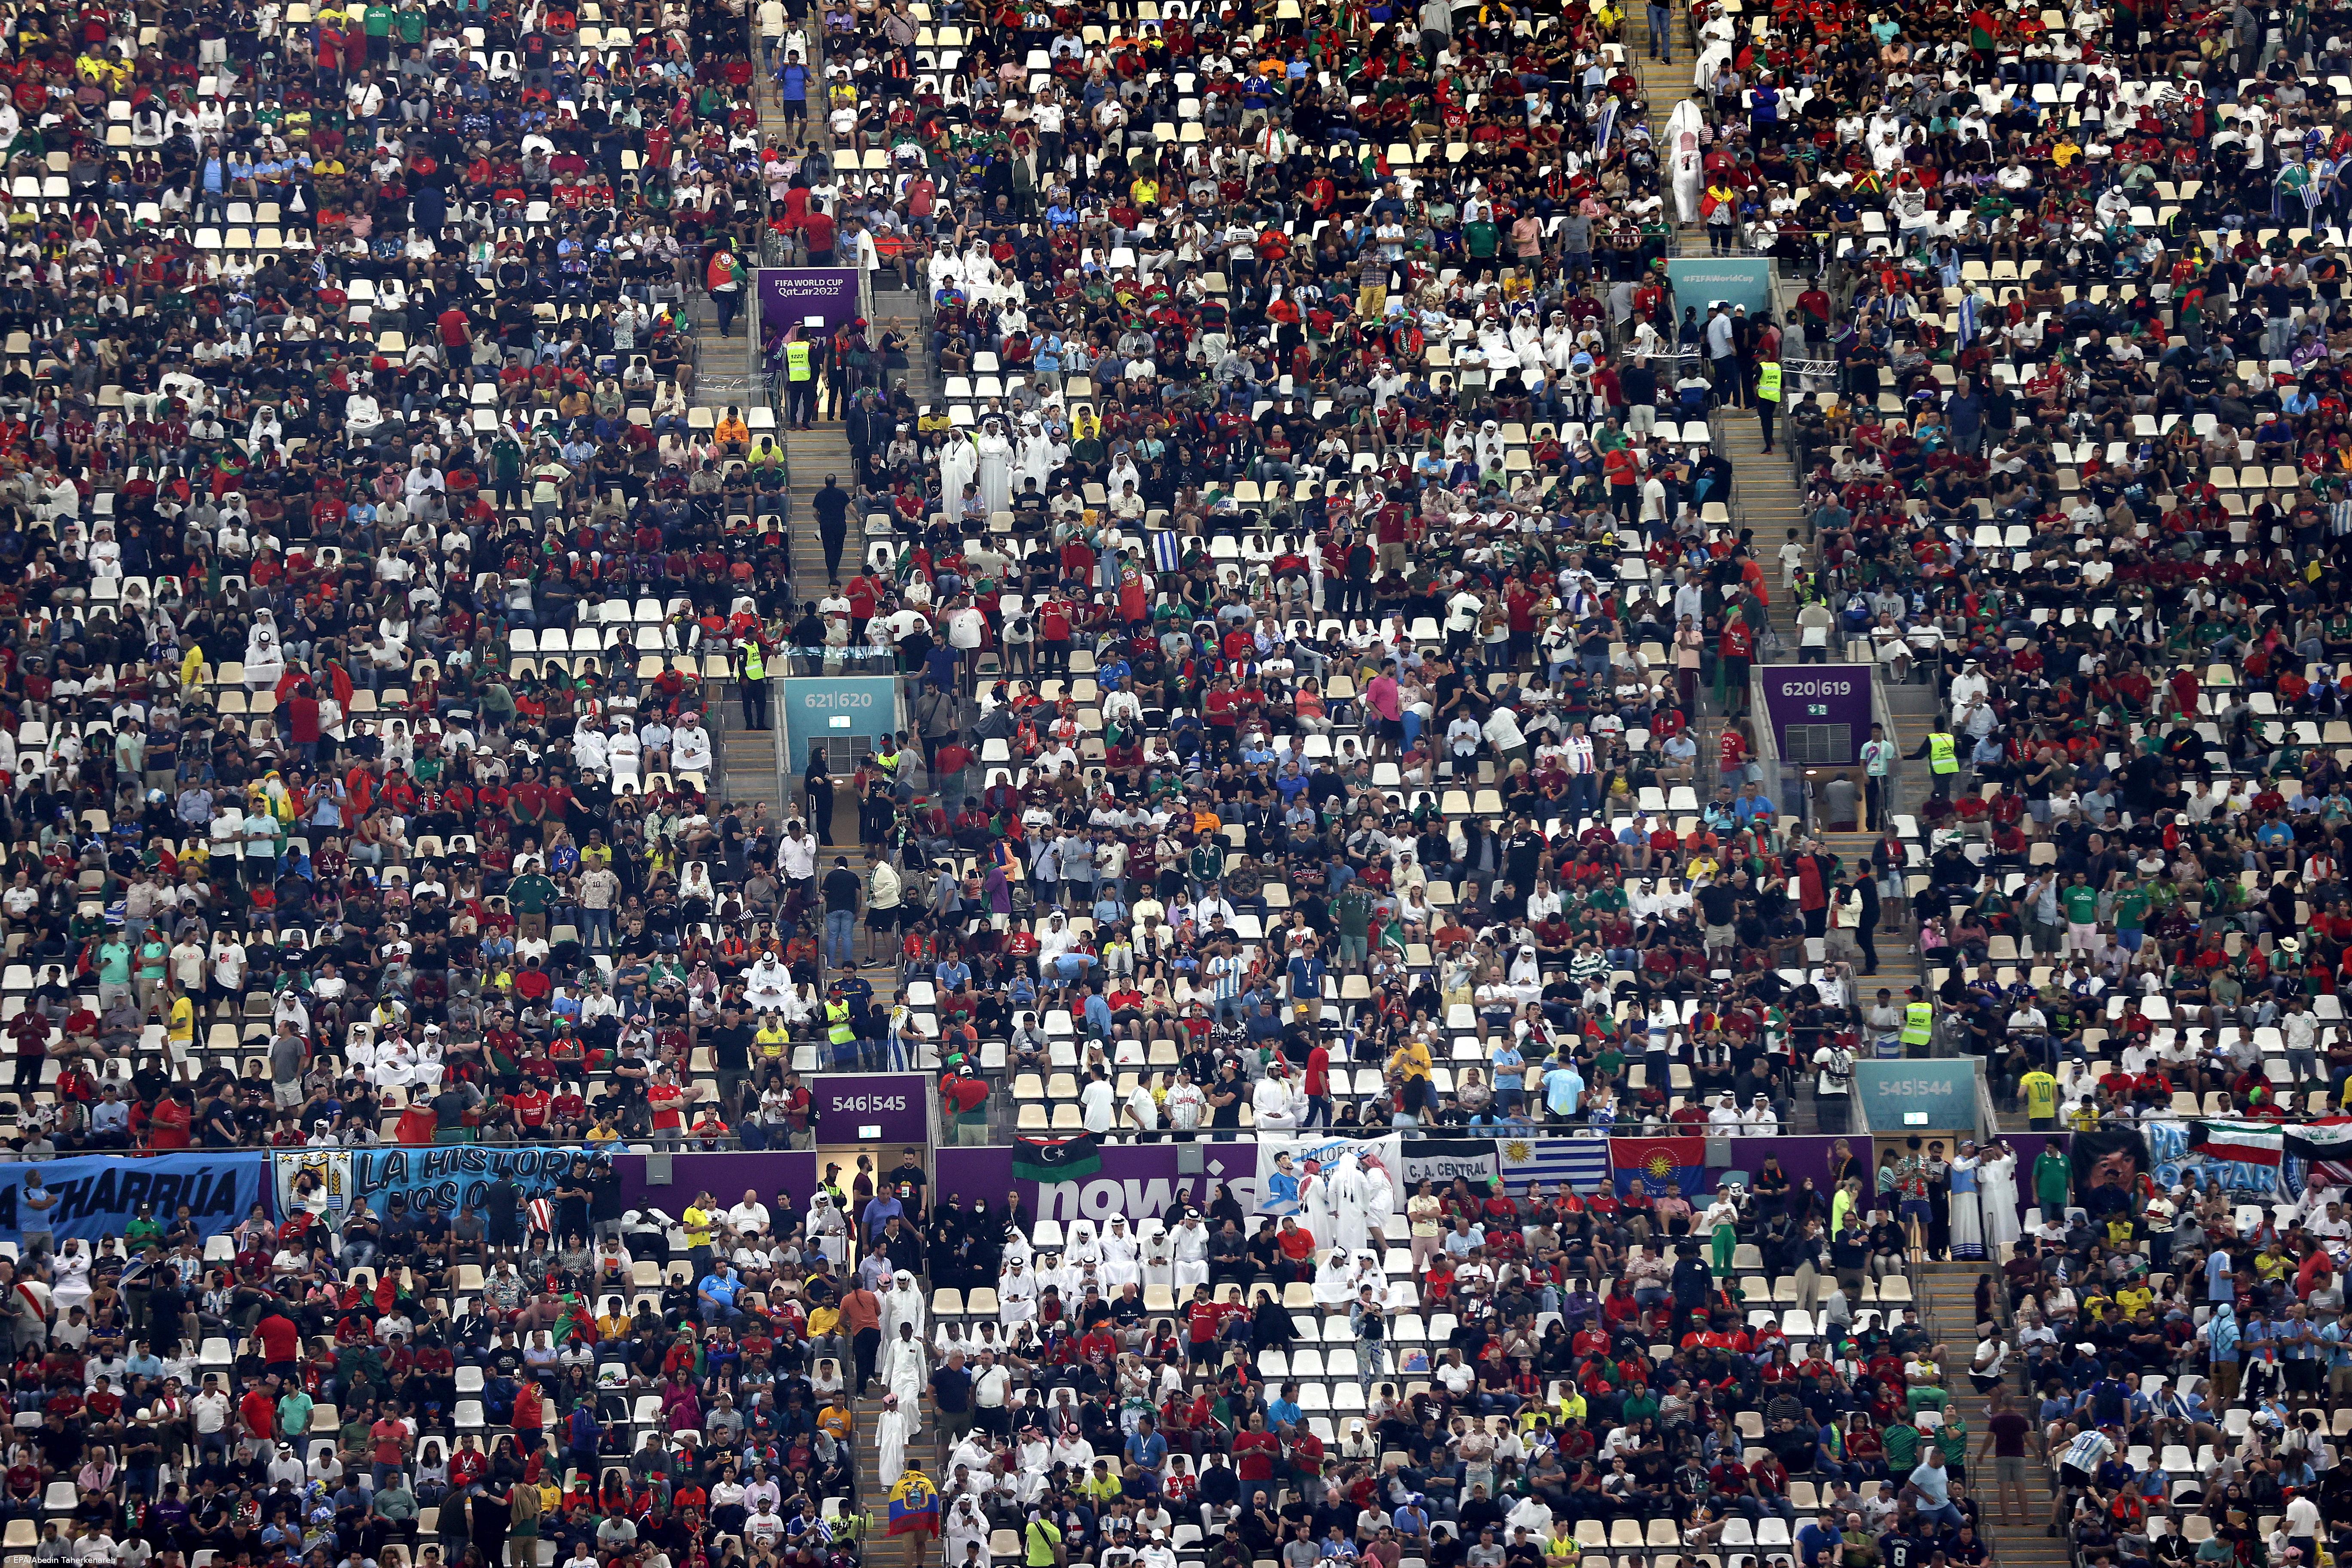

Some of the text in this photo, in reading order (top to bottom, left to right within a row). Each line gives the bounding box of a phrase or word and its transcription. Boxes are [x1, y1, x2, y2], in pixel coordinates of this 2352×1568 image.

[1683, 275, 1754, 283] #FIFAWorldCup
[1390, 514, 1394, 525] 7
[358, 1151, 409, 1195] LA
[1437, 1162, 1488, 1177] CENTRAL
[1037, 1178, 1196, 1221] now
[2076, 1436, 2093, 1450] 10
[1891, 1539, 1911, 1548] DEMPSEY
[1894, 1547, 1906, 1566] 8
